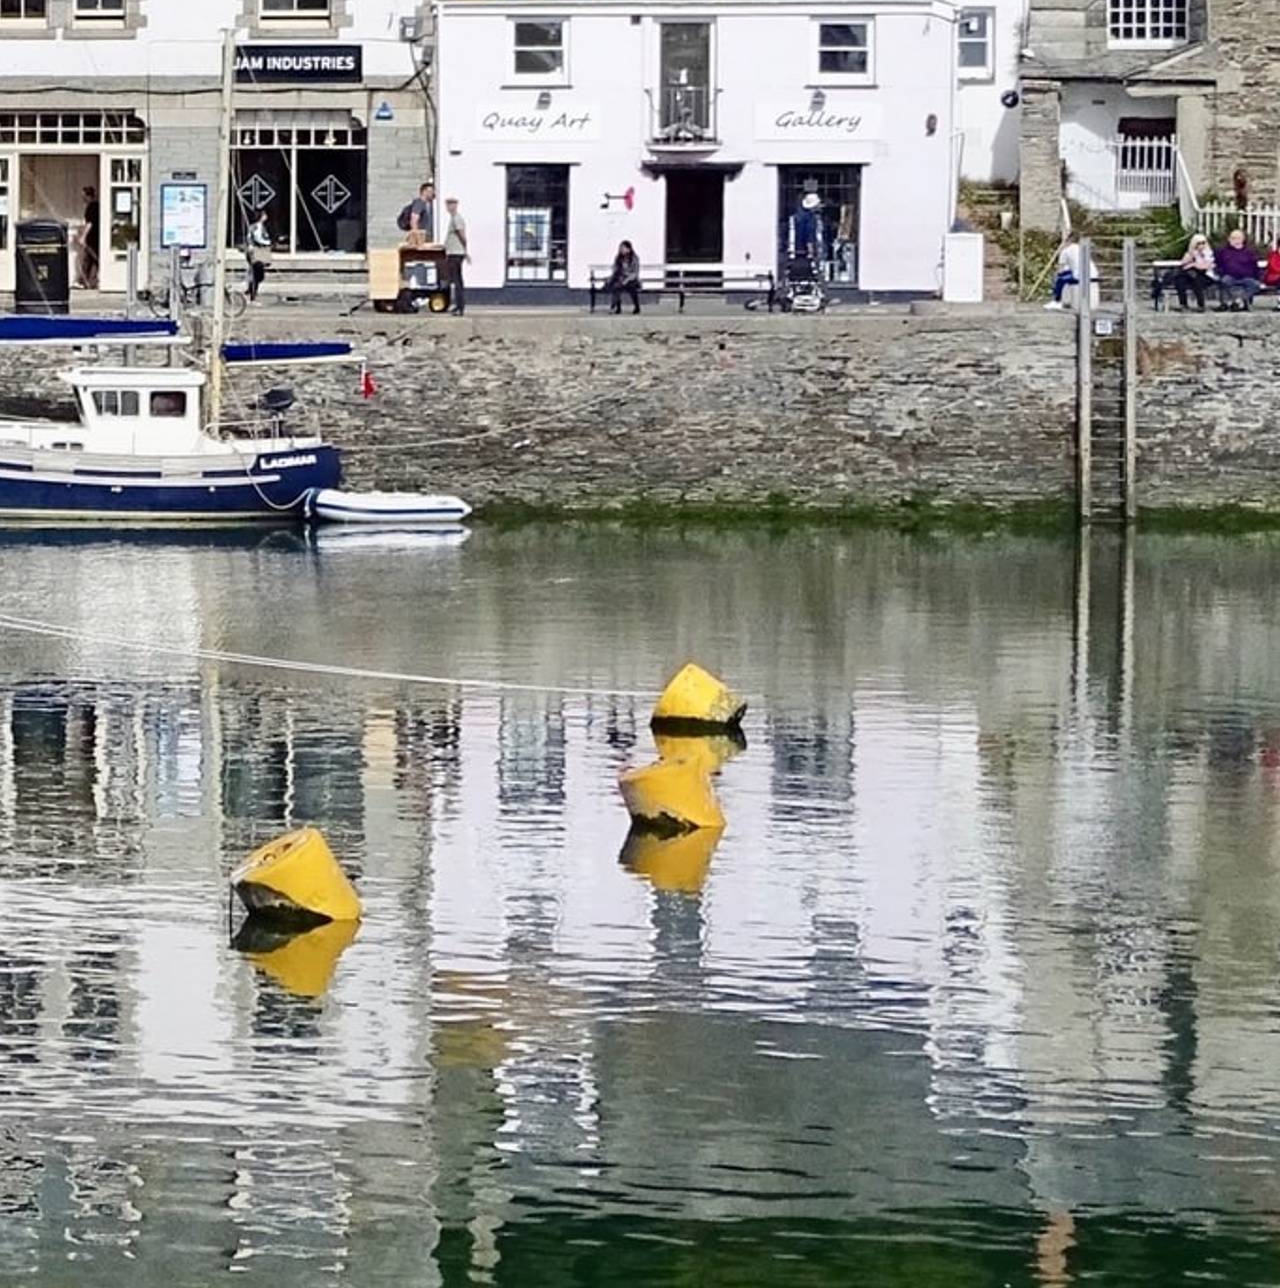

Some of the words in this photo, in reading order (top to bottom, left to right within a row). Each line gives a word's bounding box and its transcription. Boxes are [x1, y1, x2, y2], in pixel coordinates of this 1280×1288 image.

[232, 56, 263, 71] JAM
[266, 56, 355, 71] INDUSTRIES
[482, 112, 544, 133] Quay
[549, 112, 593, 130] Art
[775, 111, 863, 133] Gallery
